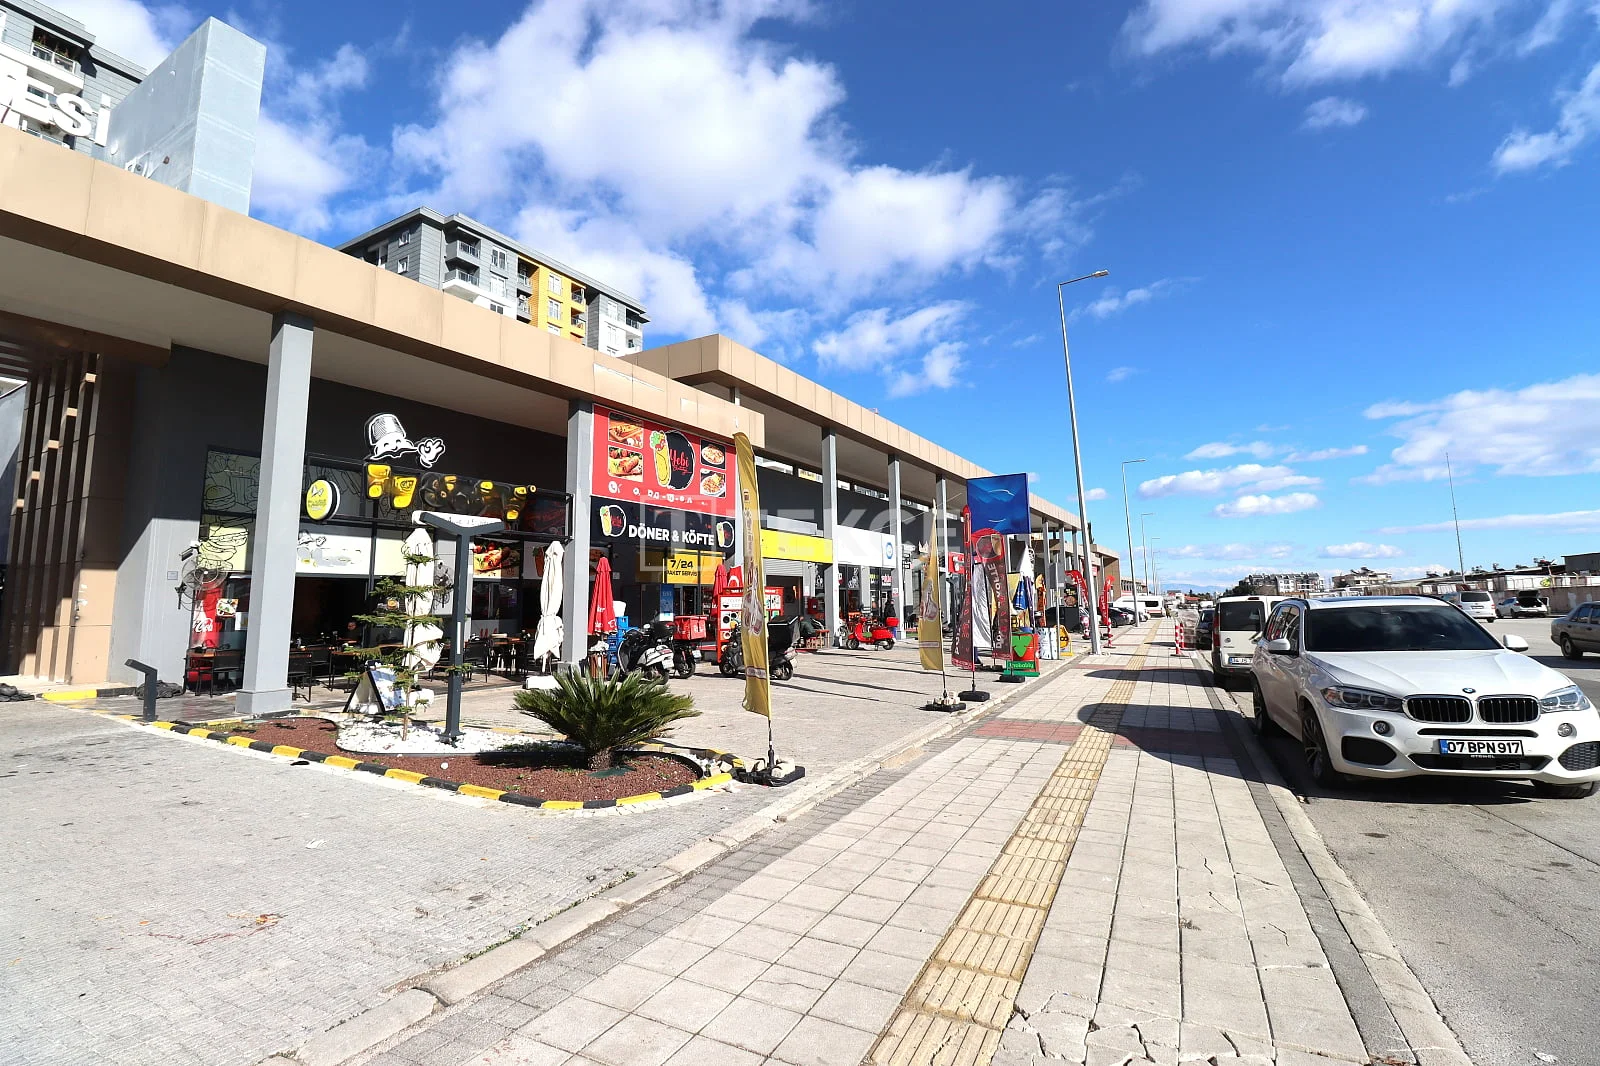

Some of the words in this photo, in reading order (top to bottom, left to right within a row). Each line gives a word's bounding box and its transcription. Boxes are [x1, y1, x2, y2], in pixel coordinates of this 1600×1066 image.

[628, 522, 670, 542] DÖNER
[672, 530, 680, 542] &
[682, 529, 715, 546] KÖFTE
[670, 558, 693, 570] 7/24
[1447, 741, 1465, 753] 07
[1468, 741, 1496, 754] BPN
[1498, 741, 1520, 754] 917
